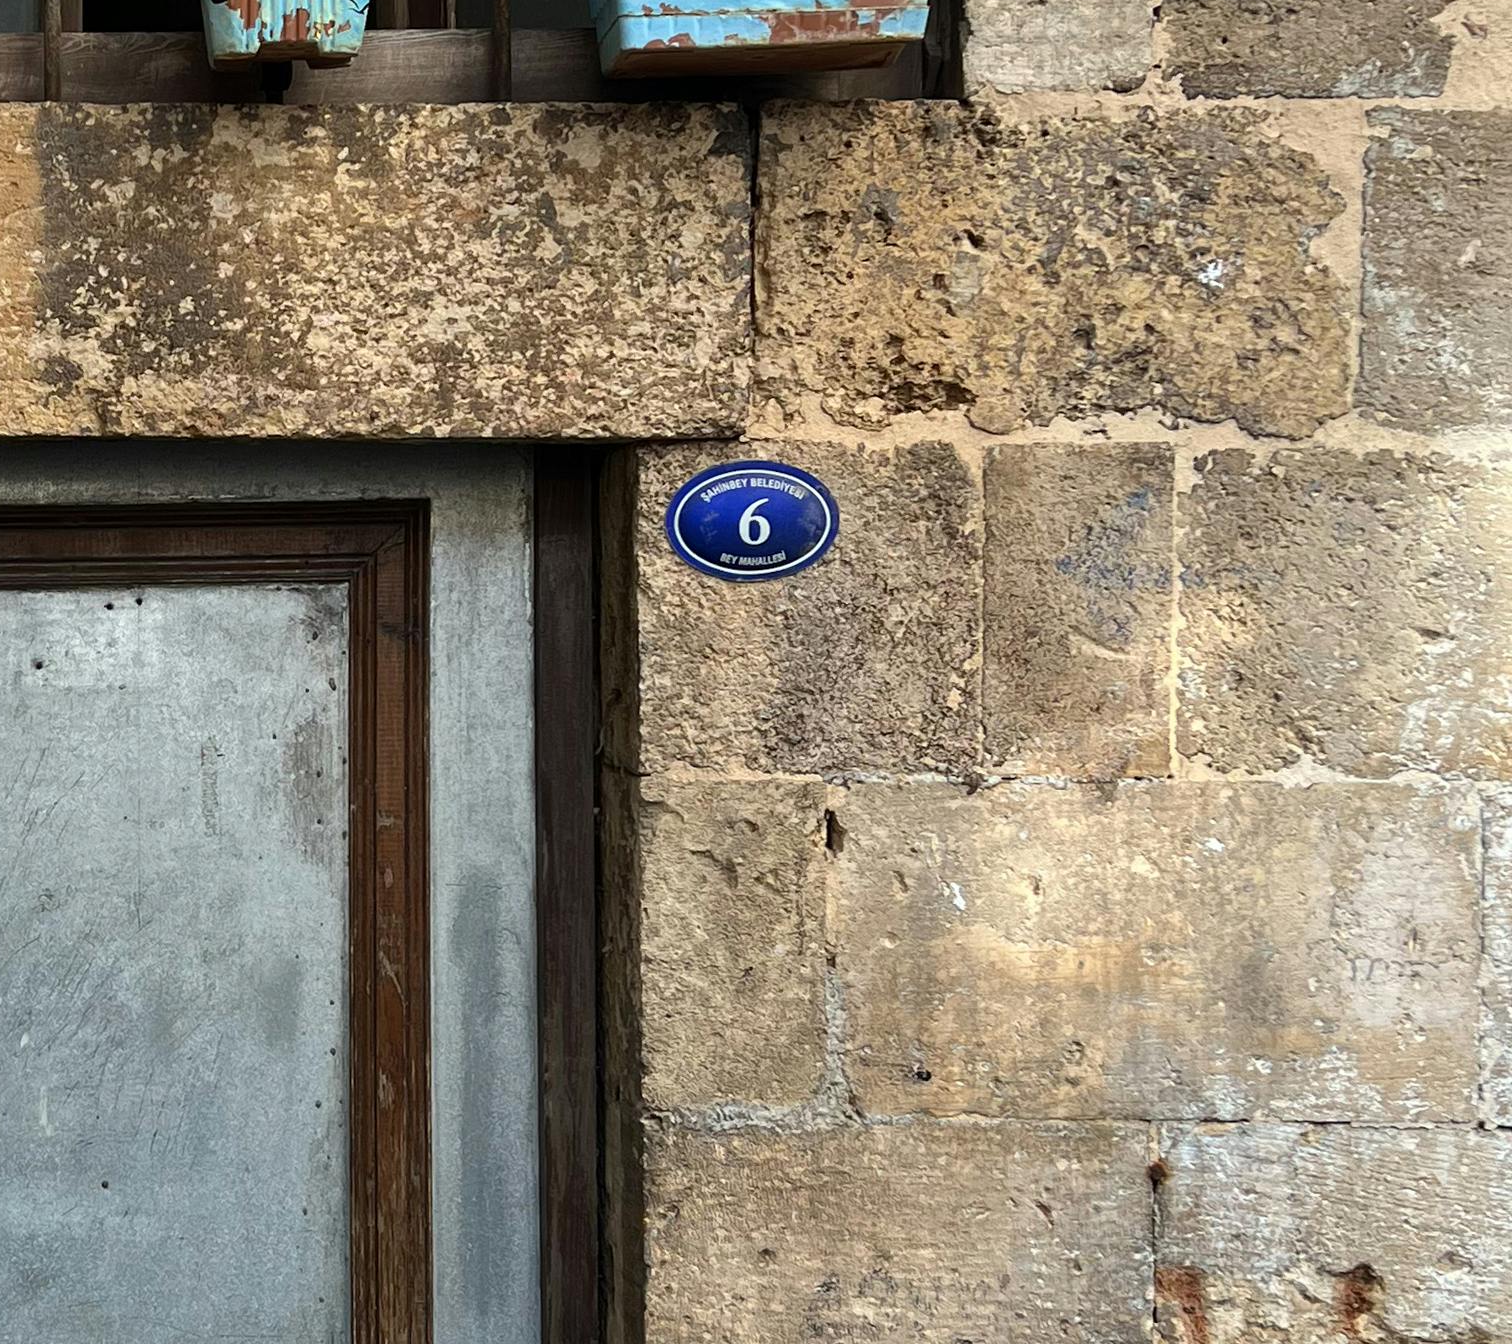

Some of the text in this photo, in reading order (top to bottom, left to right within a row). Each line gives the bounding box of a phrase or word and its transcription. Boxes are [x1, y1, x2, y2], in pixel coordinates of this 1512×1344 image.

[700, 477, 805, 503] ŞAHİNBEY BELEDİYESİ
[739, 497, 771, 546] 6
[720, 550, 786, 566] BEY MAHALLESİ
